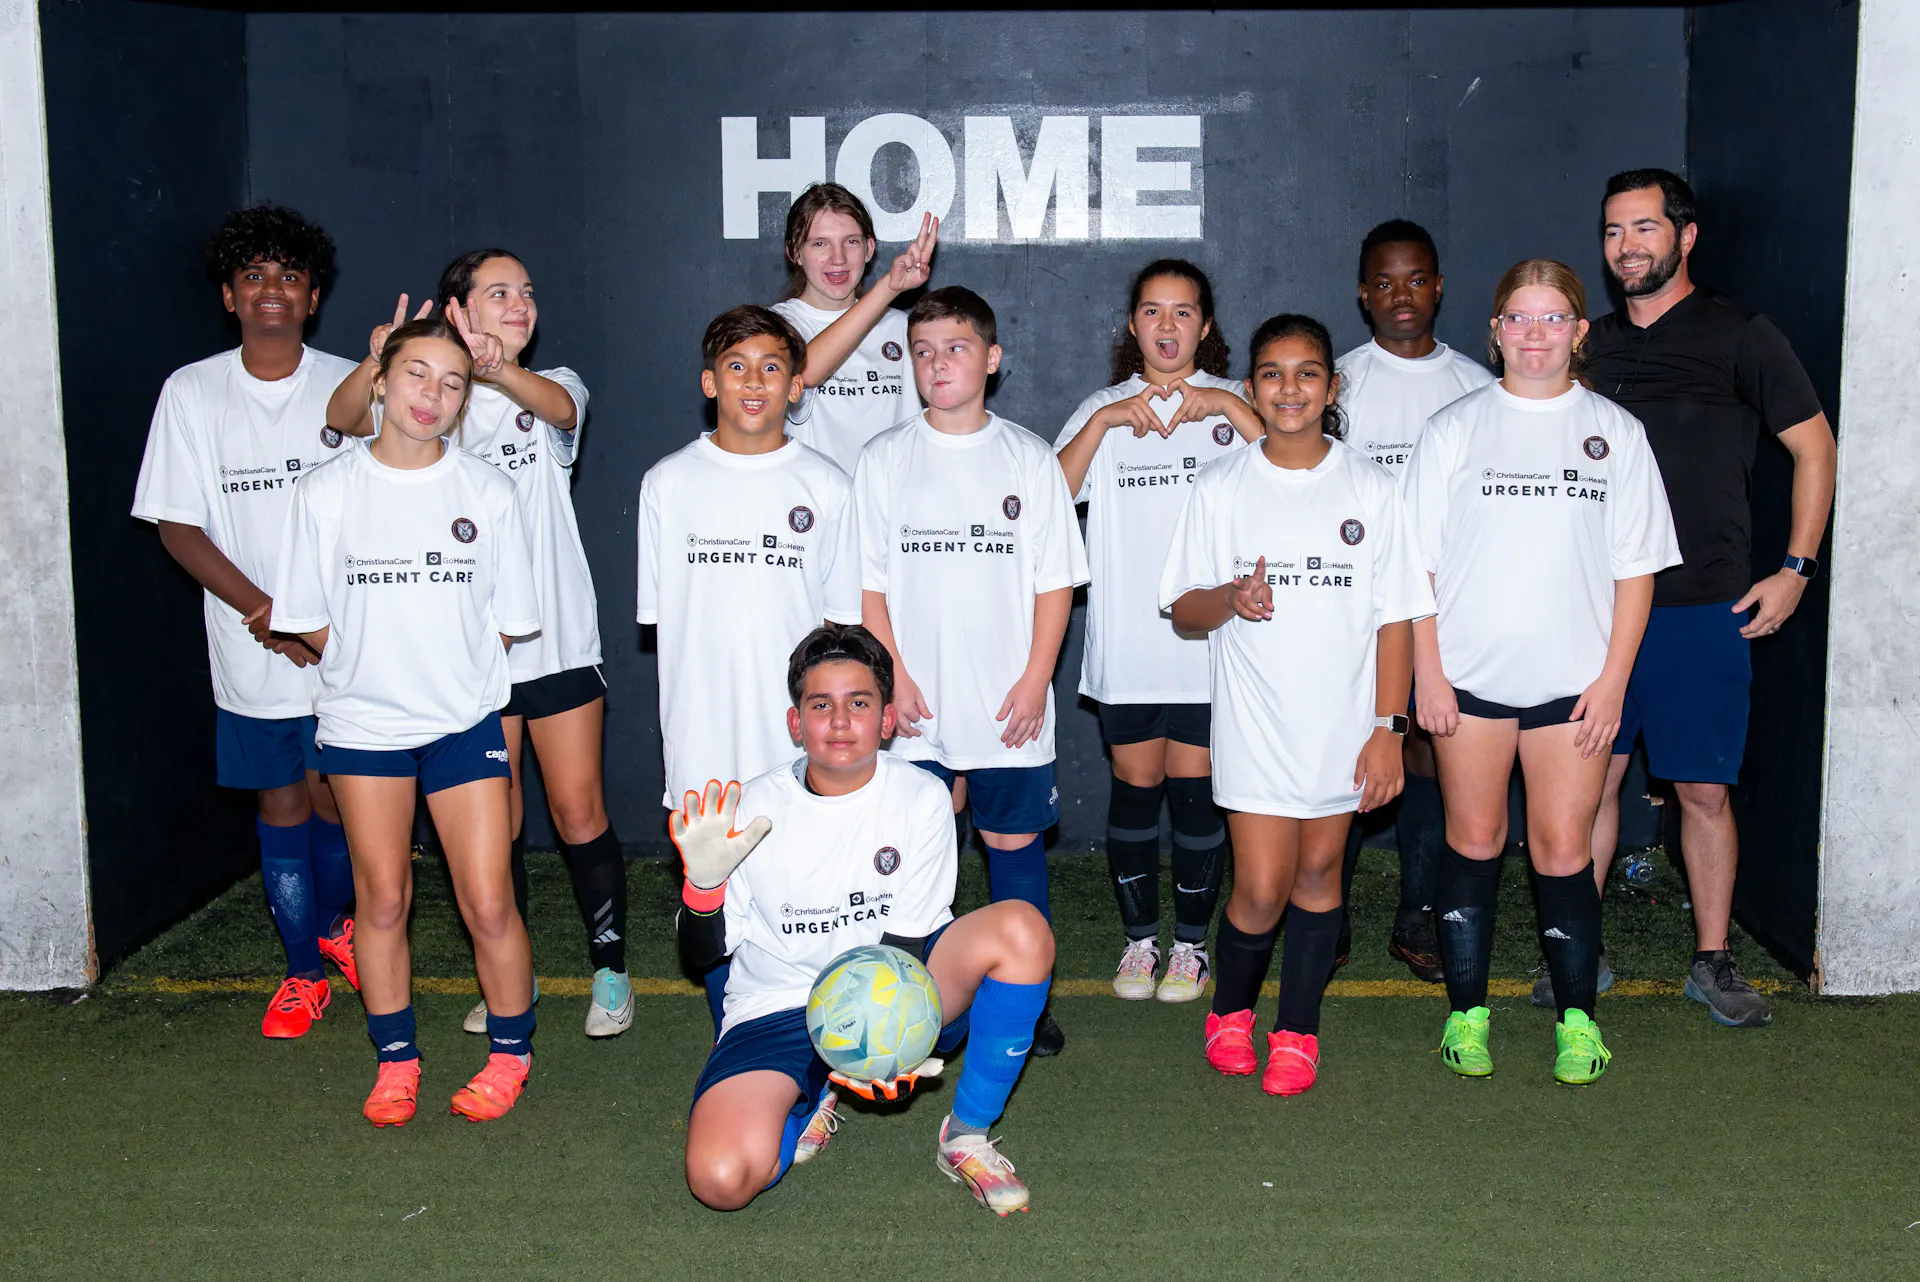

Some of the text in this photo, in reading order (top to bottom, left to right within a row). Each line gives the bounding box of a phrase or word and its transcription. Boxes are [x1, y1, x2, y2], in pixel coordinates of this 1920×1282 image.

[721, 112, 1204, 242] HOME
[818, 385, 865, 396] RGENT
[1376, 442, 1414, 450] ChristianaCar
[508, 453, 537, 470] CAR
[1371, 454, 1408, 465] RGE
[228, 467, 277, 477] ChristianaCare
[1126, 463, 1173, 472] ChristianaCare
[1118, 474, 1180, 488] URGENT
[1496, 472, 1551, 480] ChristianaCare
[221, 478, 284, 493] URGENT
[1482, 485, 1606, 502] URGENT CARE
[911, 528, 1014, 538] ChristianaCare GoHealth
[698, 538, 805, 552] ChristianaCare GoHelth
[901, 541, 1014, 554] URGENT CARE
[356, 557, 476, 567] ChristianaCare GoHealth
[687, 552, 757, 564] URGENT
[1243, 561, 1353, 570] ChranaCare GoHealth
[347, 571, 473, 585] URGENT CARE
[1309, 575, 1353, 587] CARE
[794, 906, 840, 916] ChristianaCa
[781, 904, 891, 934] URGENT CAE
